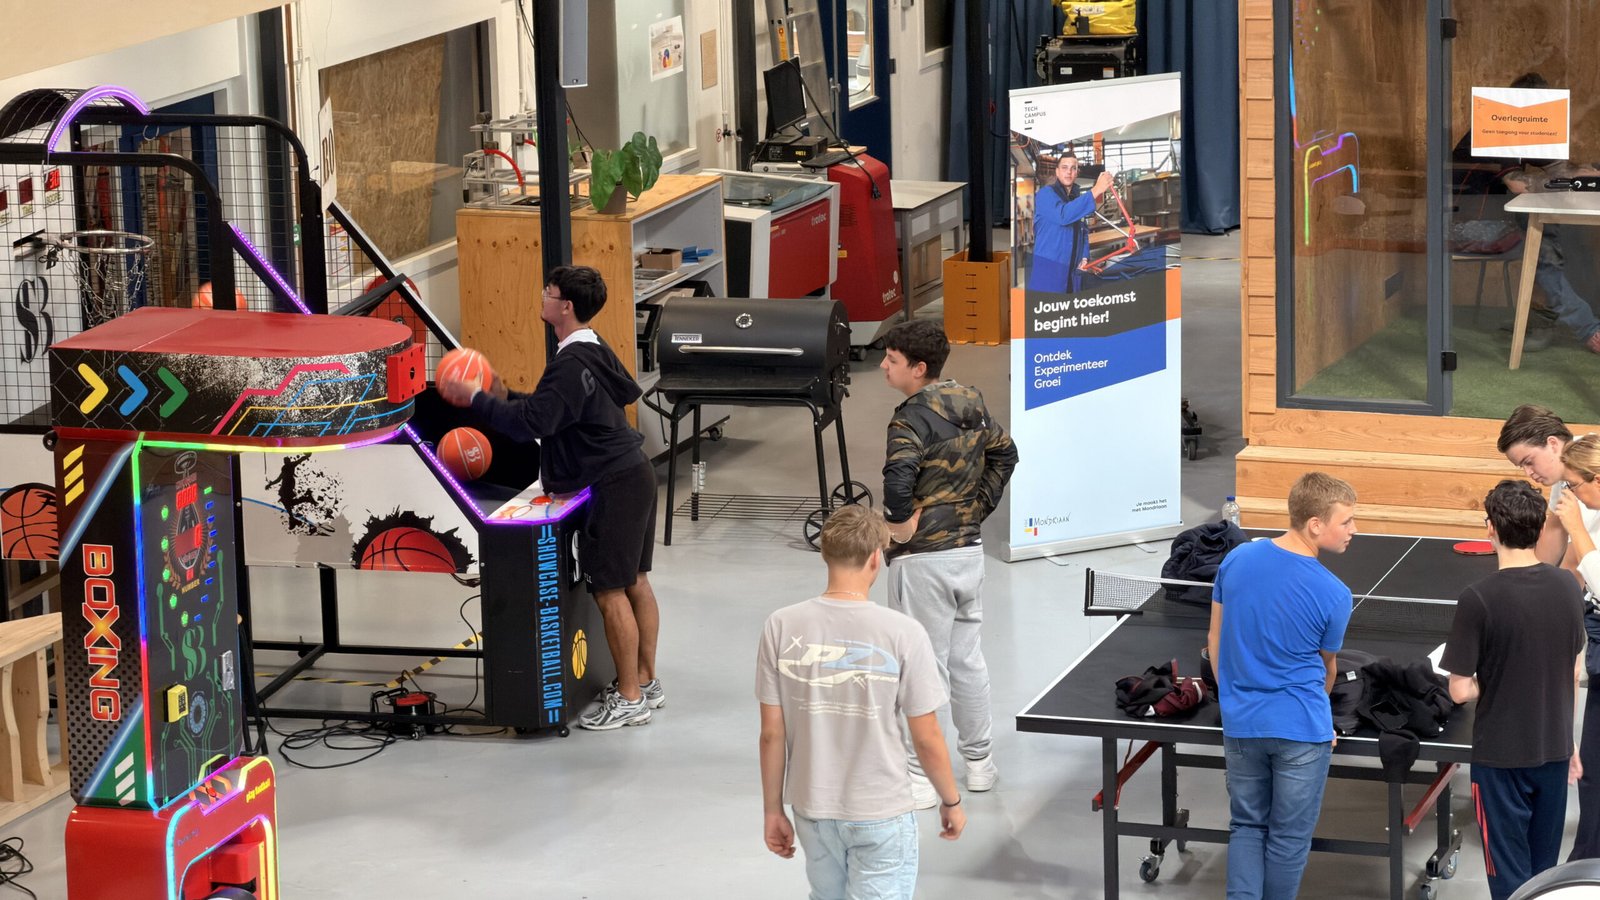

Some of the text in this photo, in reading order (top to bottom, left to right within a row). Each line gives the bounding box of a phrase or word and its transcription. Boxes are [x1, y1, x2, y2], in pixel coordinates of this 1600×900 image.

[1491, 114, 1548, 123] Overlegruimte
[1034, 291, 1136, 314] Jouw toekomst
[1034, 310, 1110, 333] begint hier!
[1034, 350, 1073, 364] Ontdek
[1034, 359, 1108, 377] Experimenteer
[1034, 376, 1061, 389] Groei
[82, 544, 121, 721] BOXING
